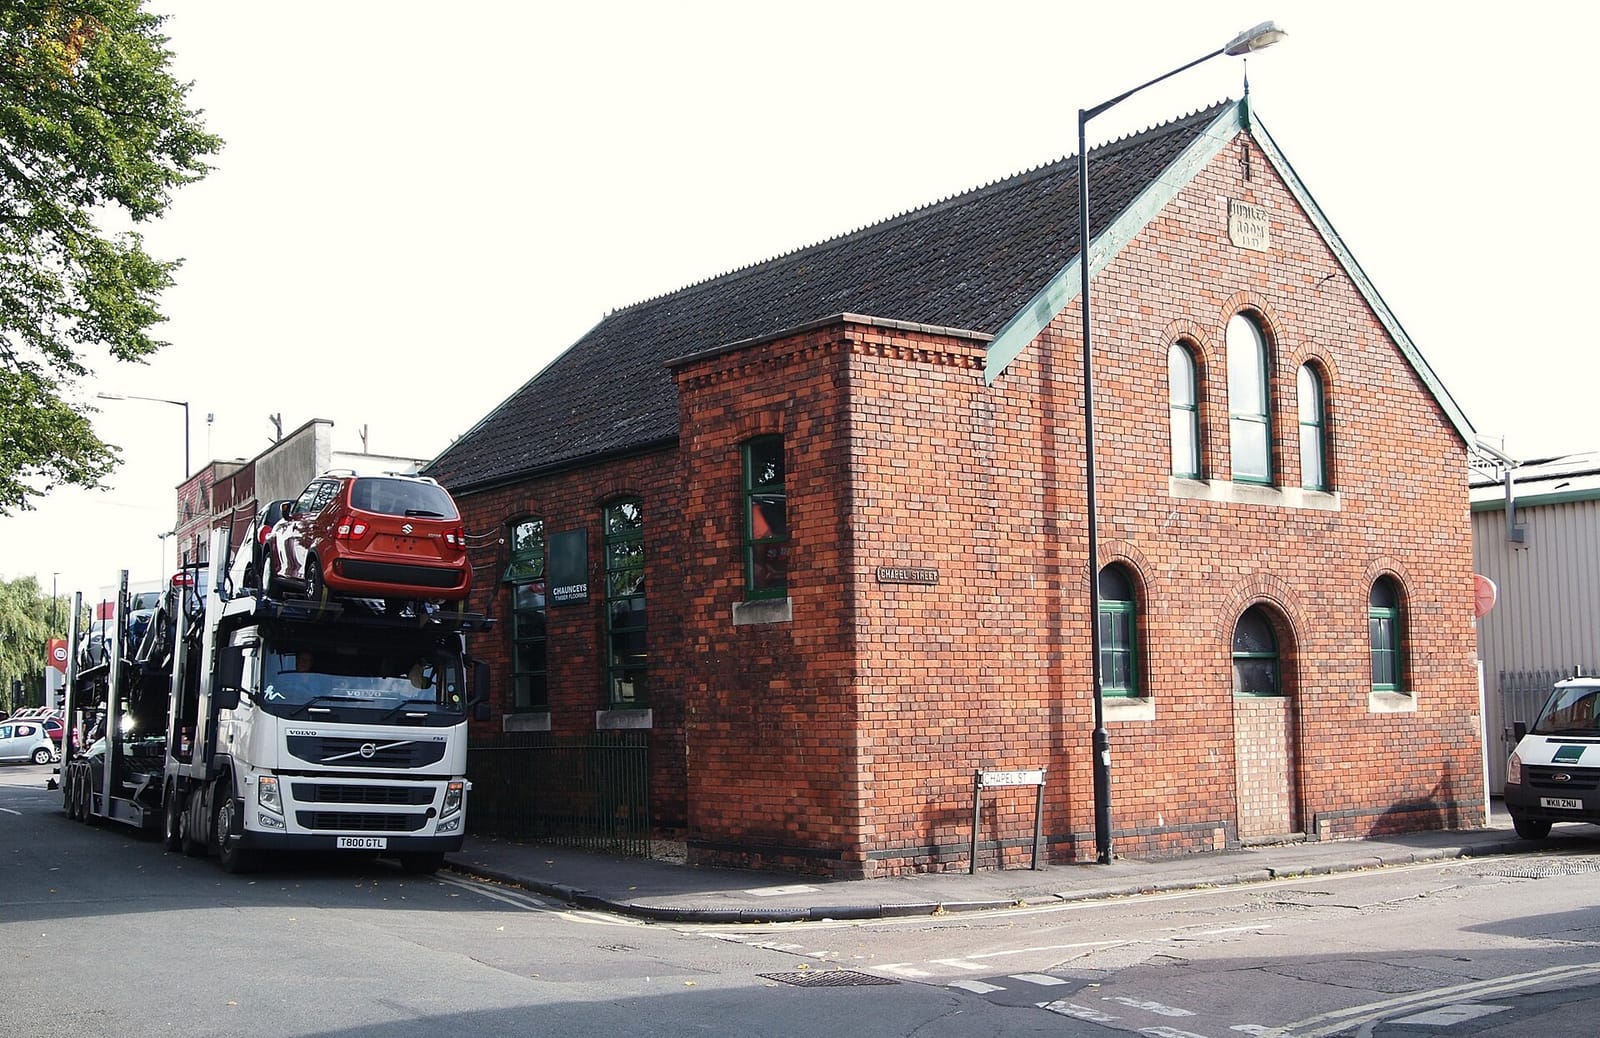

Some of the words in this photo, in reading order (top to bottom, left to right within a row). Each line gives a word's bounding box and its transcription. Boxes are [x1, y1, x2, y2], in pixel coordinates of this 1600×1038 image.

[880, 569, 909, 580] CHAPEL
[911, 570, 938, 581] STREET
[553, 583, 587, 596] CHAUNCEYS
[984, 772, 1014, 785] CHAPEL
[1017, 772, 1027, 784] ST
[1561, 799, 1577, 808] ZNU
[341, 837, 364, 848] T800
[366, 838, 384, 848] GTL
